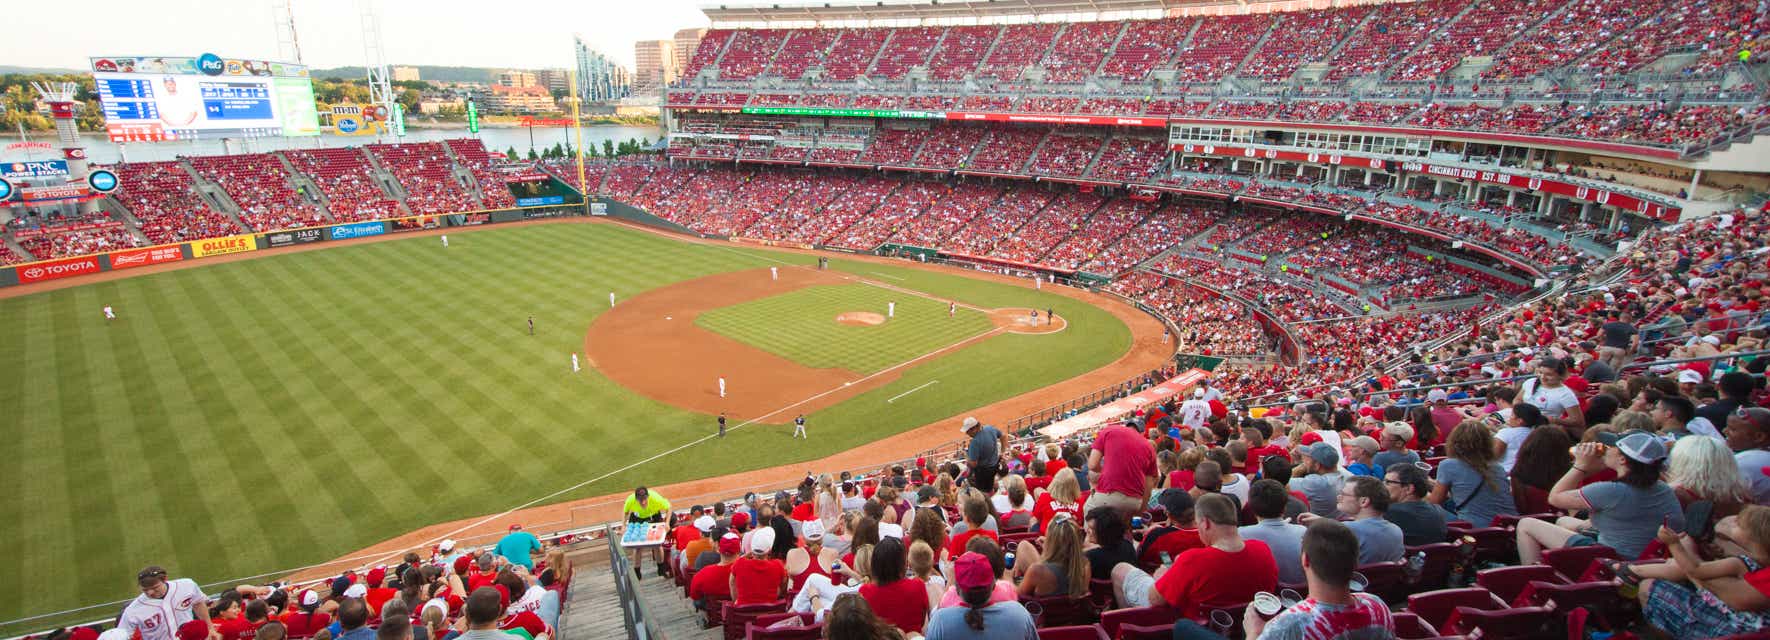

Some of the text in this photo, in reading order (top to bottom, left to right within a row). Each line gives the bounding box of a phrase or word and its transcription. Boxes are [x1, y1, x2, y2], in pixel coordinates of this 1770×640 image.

[203, 61, 222, 69] P&G
[26, 161, 59, 172] PNC
[1428, 164, 1460, 177] CINCINNATI
[1461, 169, 1477, 179] REDS
[1482, 171, 1496, 181] EST.
[296, 229, 321, 238] JACK
[202, 238, 246, 251] OLLIE'S
[45, 261, 95, 275] TOYOTA
[144, 612, 161, 629] 67
